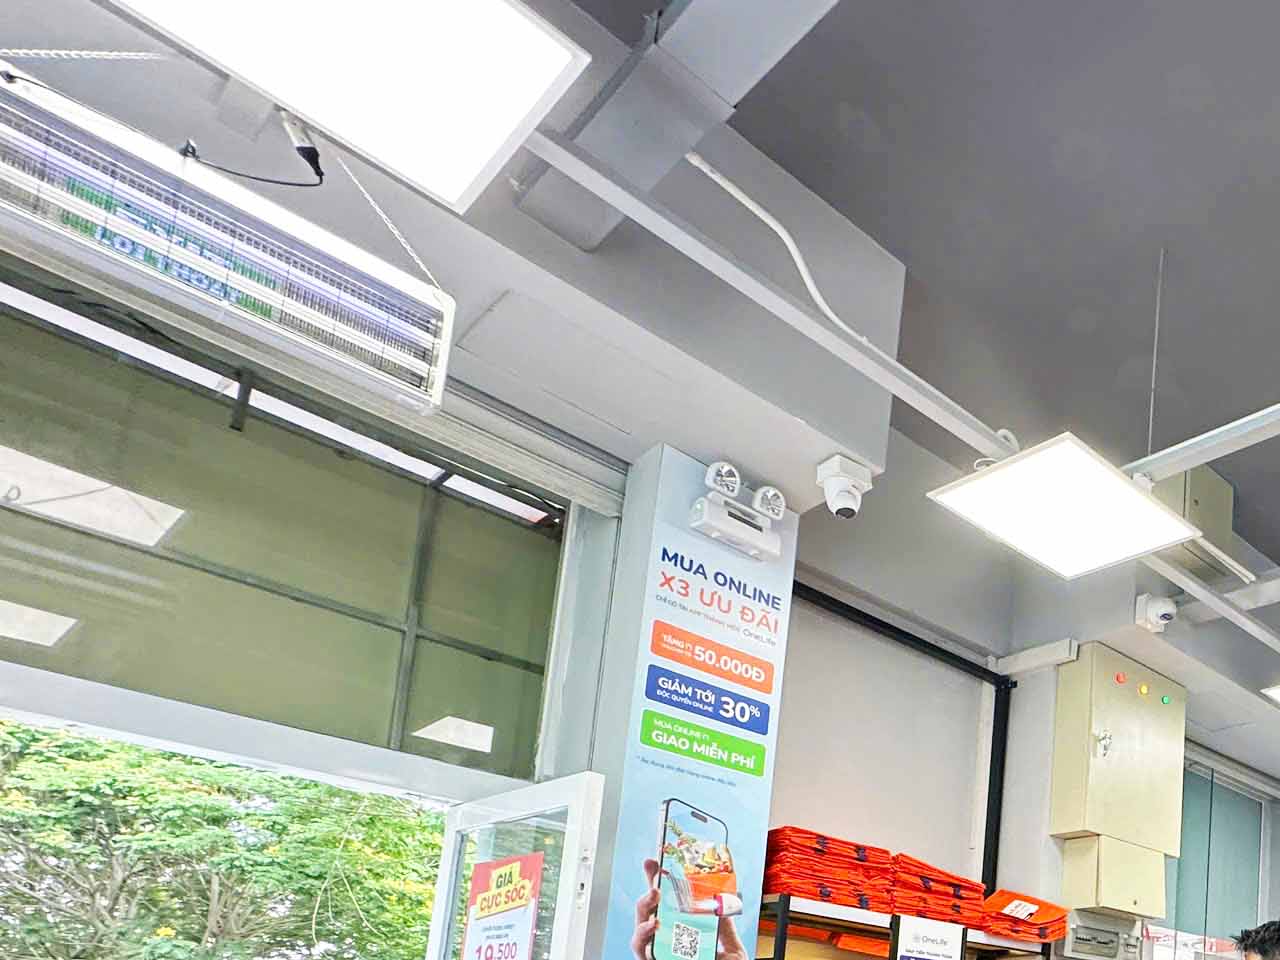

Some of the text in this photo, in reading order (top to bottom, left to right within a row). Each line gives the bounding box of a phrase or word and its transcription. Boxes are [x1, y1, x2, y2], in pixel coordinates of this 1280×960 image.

[661, 546, 782, 611] MUA ONLINE
[659, 571, 690, 598] X3
[700, 586, 733, 614] ƯU
[739, 603, 779, 634] ĐÃI
[694, 646, 766, 682] 50.000Đ
[658, 677, 716, 704] GIẢM TỚI
[719, 696, 761, 723] 30%
[652, 730, 756, 769] GIAO MIỄN PHÍ
